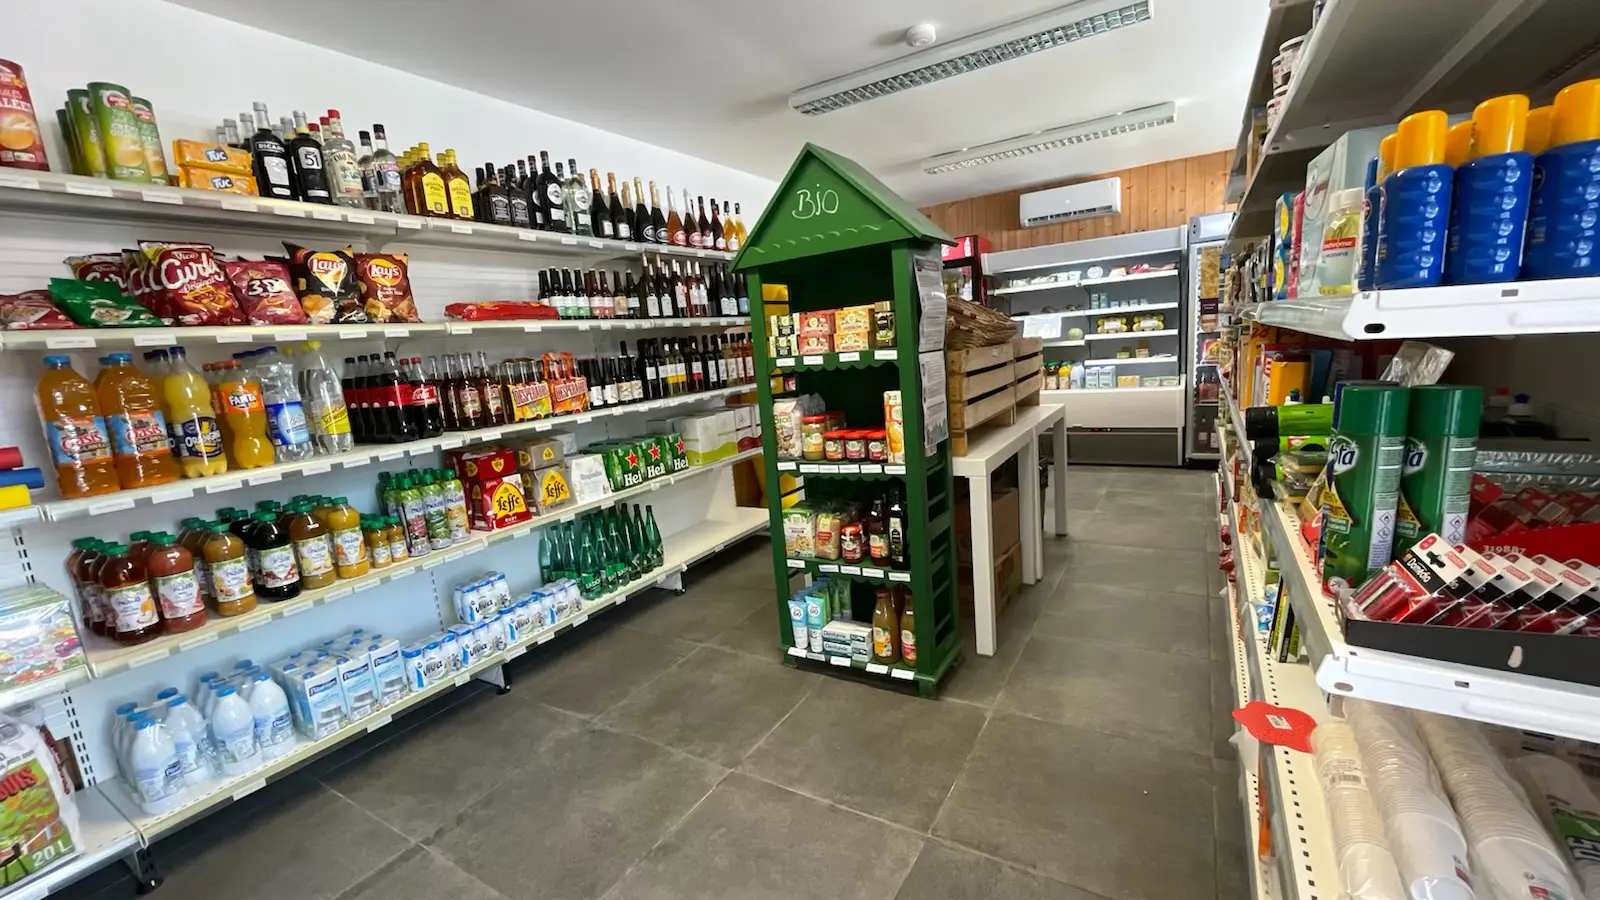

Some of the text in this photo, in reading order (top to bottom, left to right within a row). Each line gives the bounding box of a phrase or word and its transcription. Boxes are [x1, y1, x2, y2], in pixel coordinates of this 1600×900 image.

[206, 150, 227, 161] TUC
[305, 152, 319, 167] 51
[212, 178, 232, 188] TUC
[161, 252, 224, 290] Curly
[371, 264, 399, 279] Lay's
[127, 425, 162, 441] Oasis
[674, 457, 689, 470] Hei
[624, 470, 642, 487] Hei
[545, 481, 565, 499] Leffe
[496, 493, 520, 512] Leffe
[33, 840, 73, 867] 20 L
